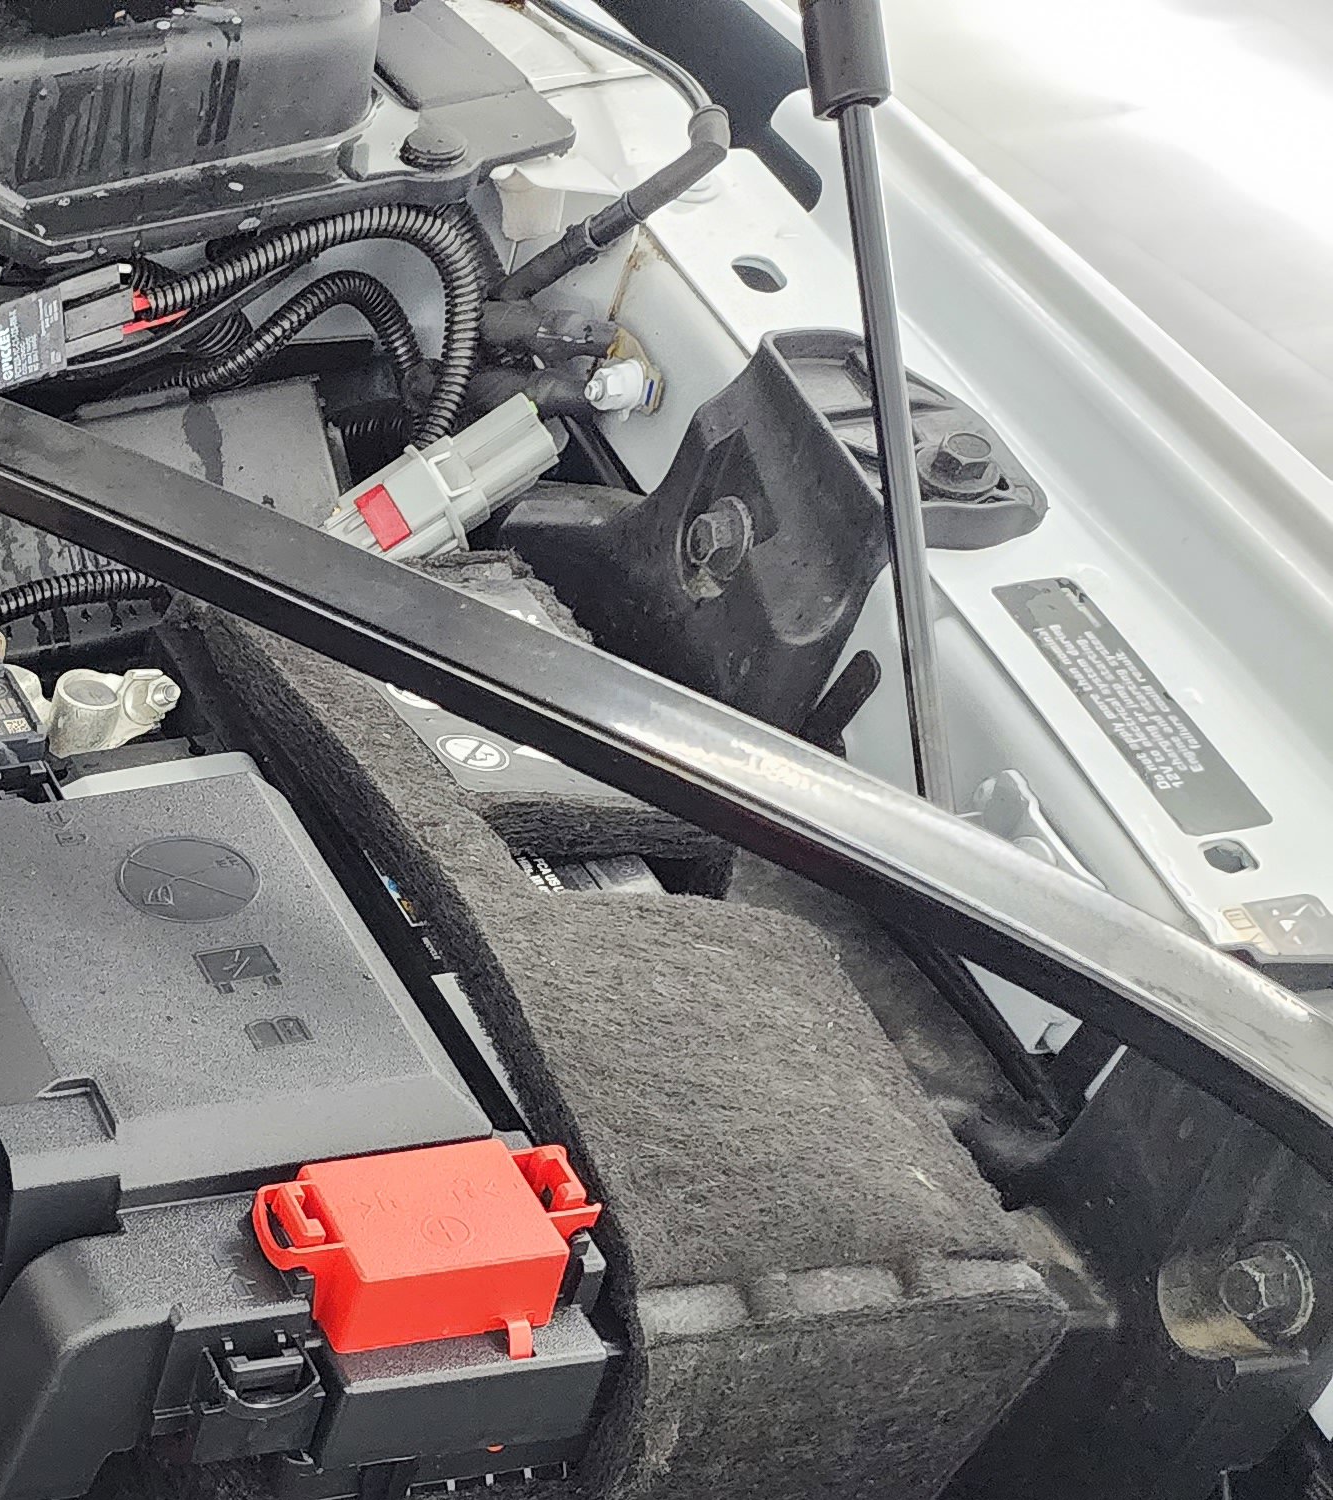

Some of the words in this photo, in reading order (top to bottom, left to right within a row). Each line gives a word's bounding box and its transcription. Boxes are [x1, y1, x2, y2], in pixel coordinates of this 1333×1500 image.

[1033, 627, 1072, 664] nominal
[1048, 623, 1079, 656] during
[1083, 630, 1119, 666] system
[1068, 667, 1093, 691] than
[1076, 658, 1111, 694] system
[1115, 668, 1155, 712] starting
[1089, 693, 1117, 719] more
[1111, 682, 1139, 708] jump
[1139, 685, 1170, 712] could
[1104, 697, 1153, 747] electrical
[1148, 714, 1174, 733] and
[1167, 714, 1201, 749] failure
[1135, 752, 1158, 771] not
[1145, 725, 1188, 770] charging
[1149, 749, 1166, 762] to
[1170, 735, 1204, 772] Engine
[1153, 773, 1171, 789] Do
[1158, 765, 1184, 787] 12V
